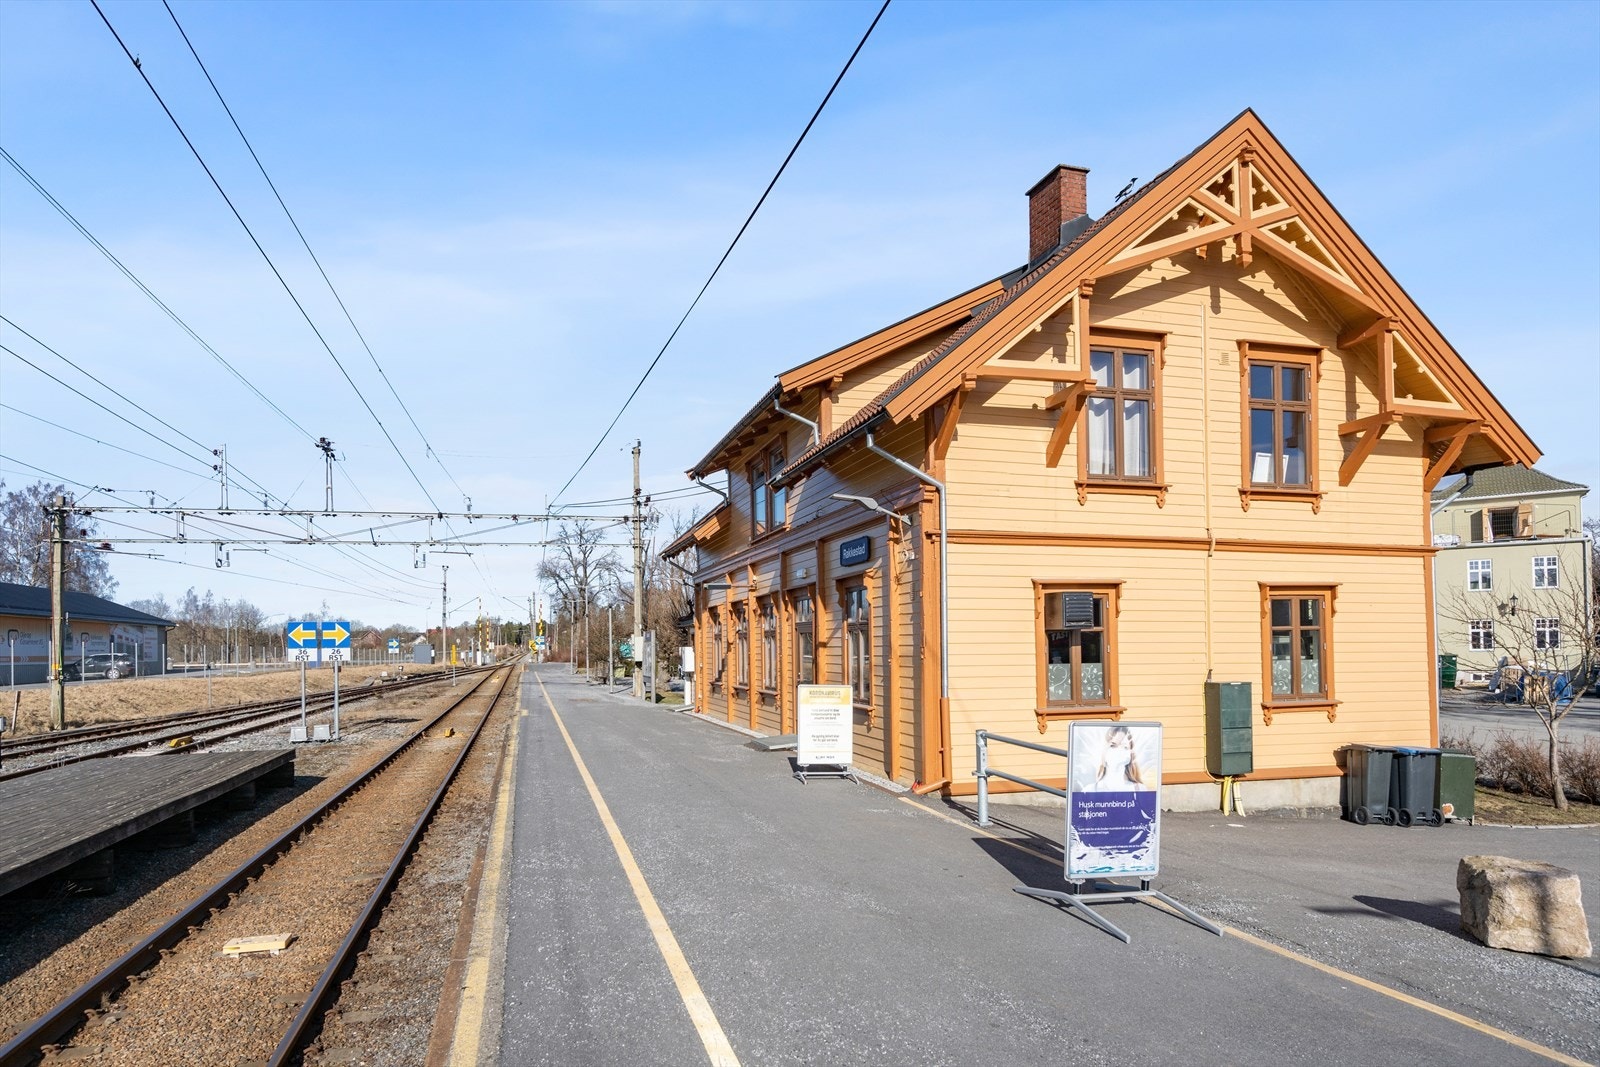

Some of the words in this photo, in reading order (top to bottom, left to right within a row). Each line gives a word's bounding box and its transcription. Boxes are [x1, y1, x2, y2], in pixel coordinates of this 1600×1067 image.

[842, 543, 866, 559] Rakkestad
[1095, 800, 1127, 808] munnbind
[1127, 800, 1136, 809] på
